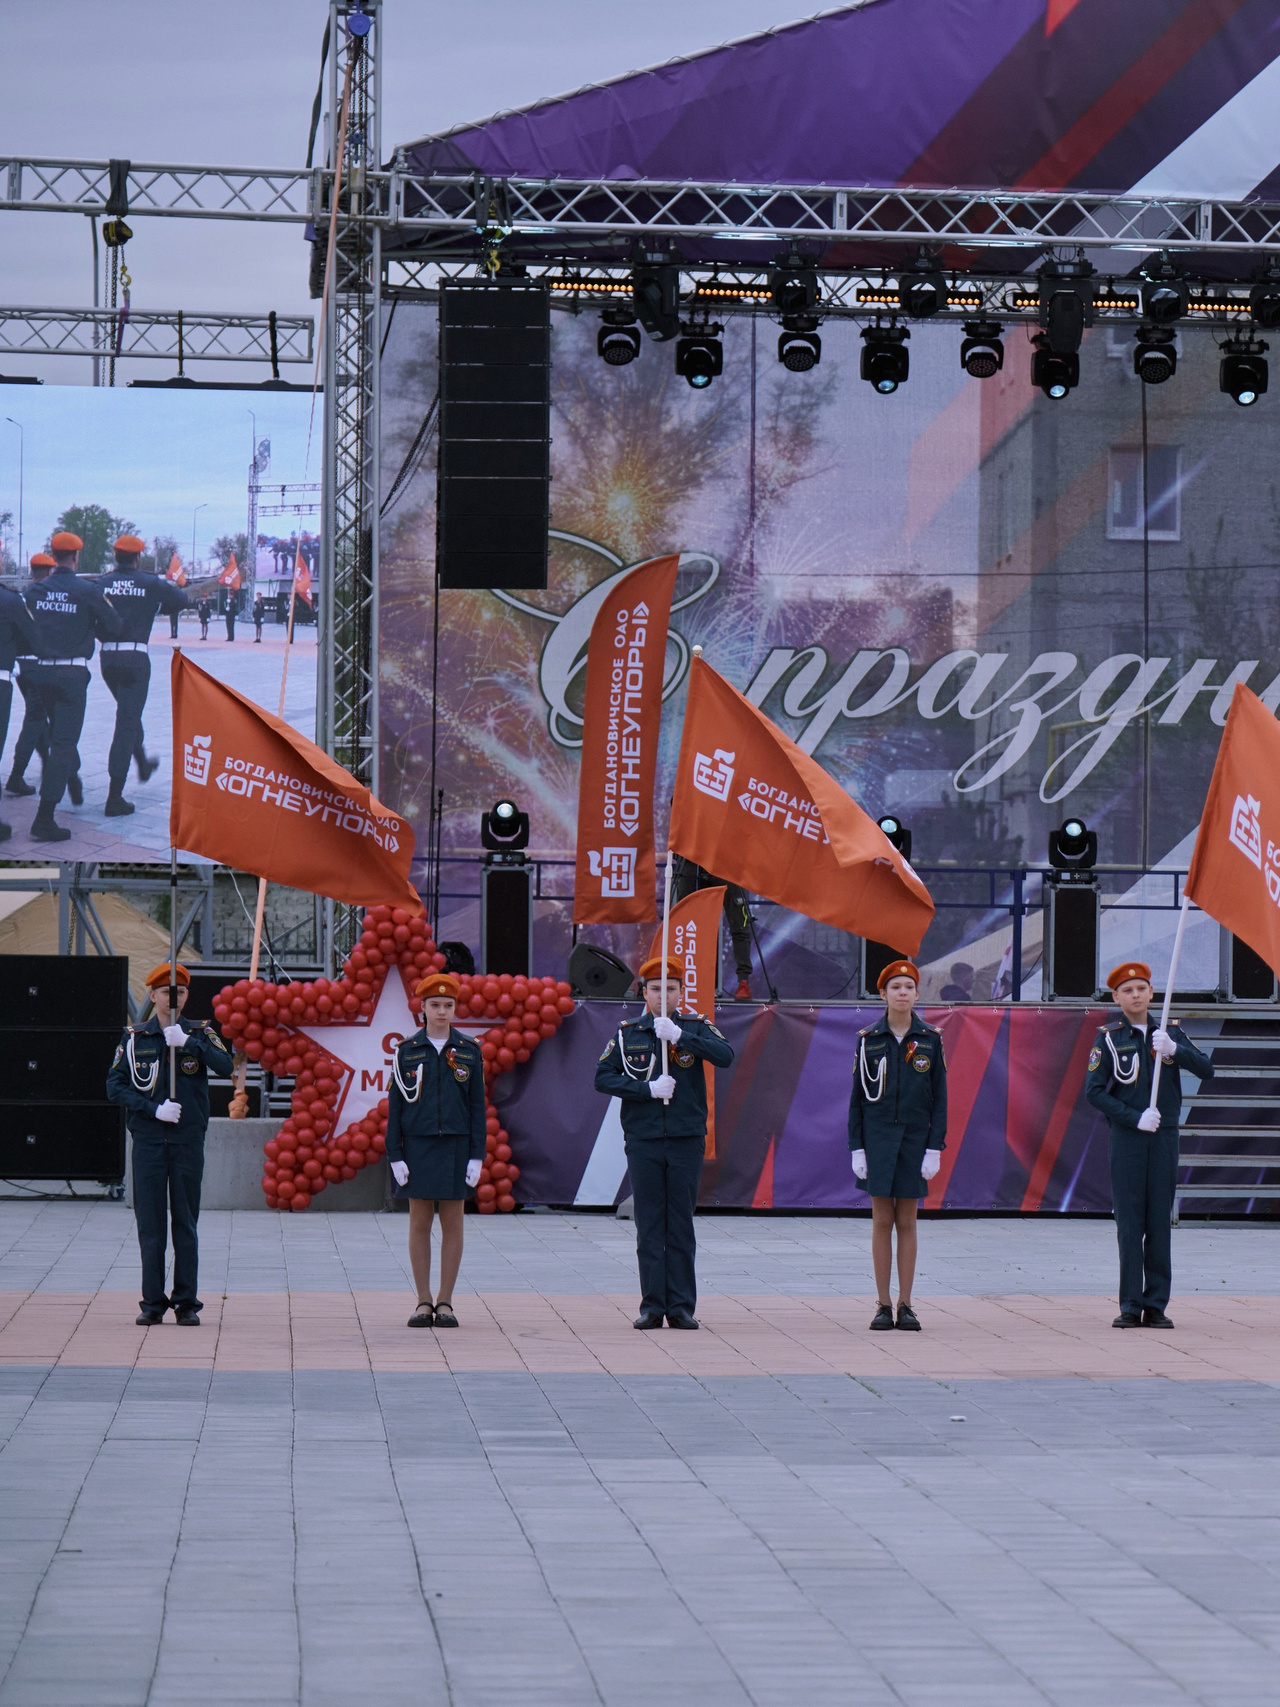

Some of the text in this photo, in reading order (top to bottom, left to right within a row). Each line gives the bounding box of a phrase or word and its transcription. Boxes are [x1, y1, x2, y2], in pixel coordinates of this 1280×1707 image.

[112, 580, 135, 588] МЧС
[45, 591, 69, 602] МЧС
[103, 586, 146, 597] РОССИИ
[36, 600, 77, 614] РОССИИ
[603, 608, 629, 830] БОГДАНОВИЧСКОЕ ОАО
[747, 777, 821, 817] БОГДАНО
[674, 925, 684, 955] ОАО
